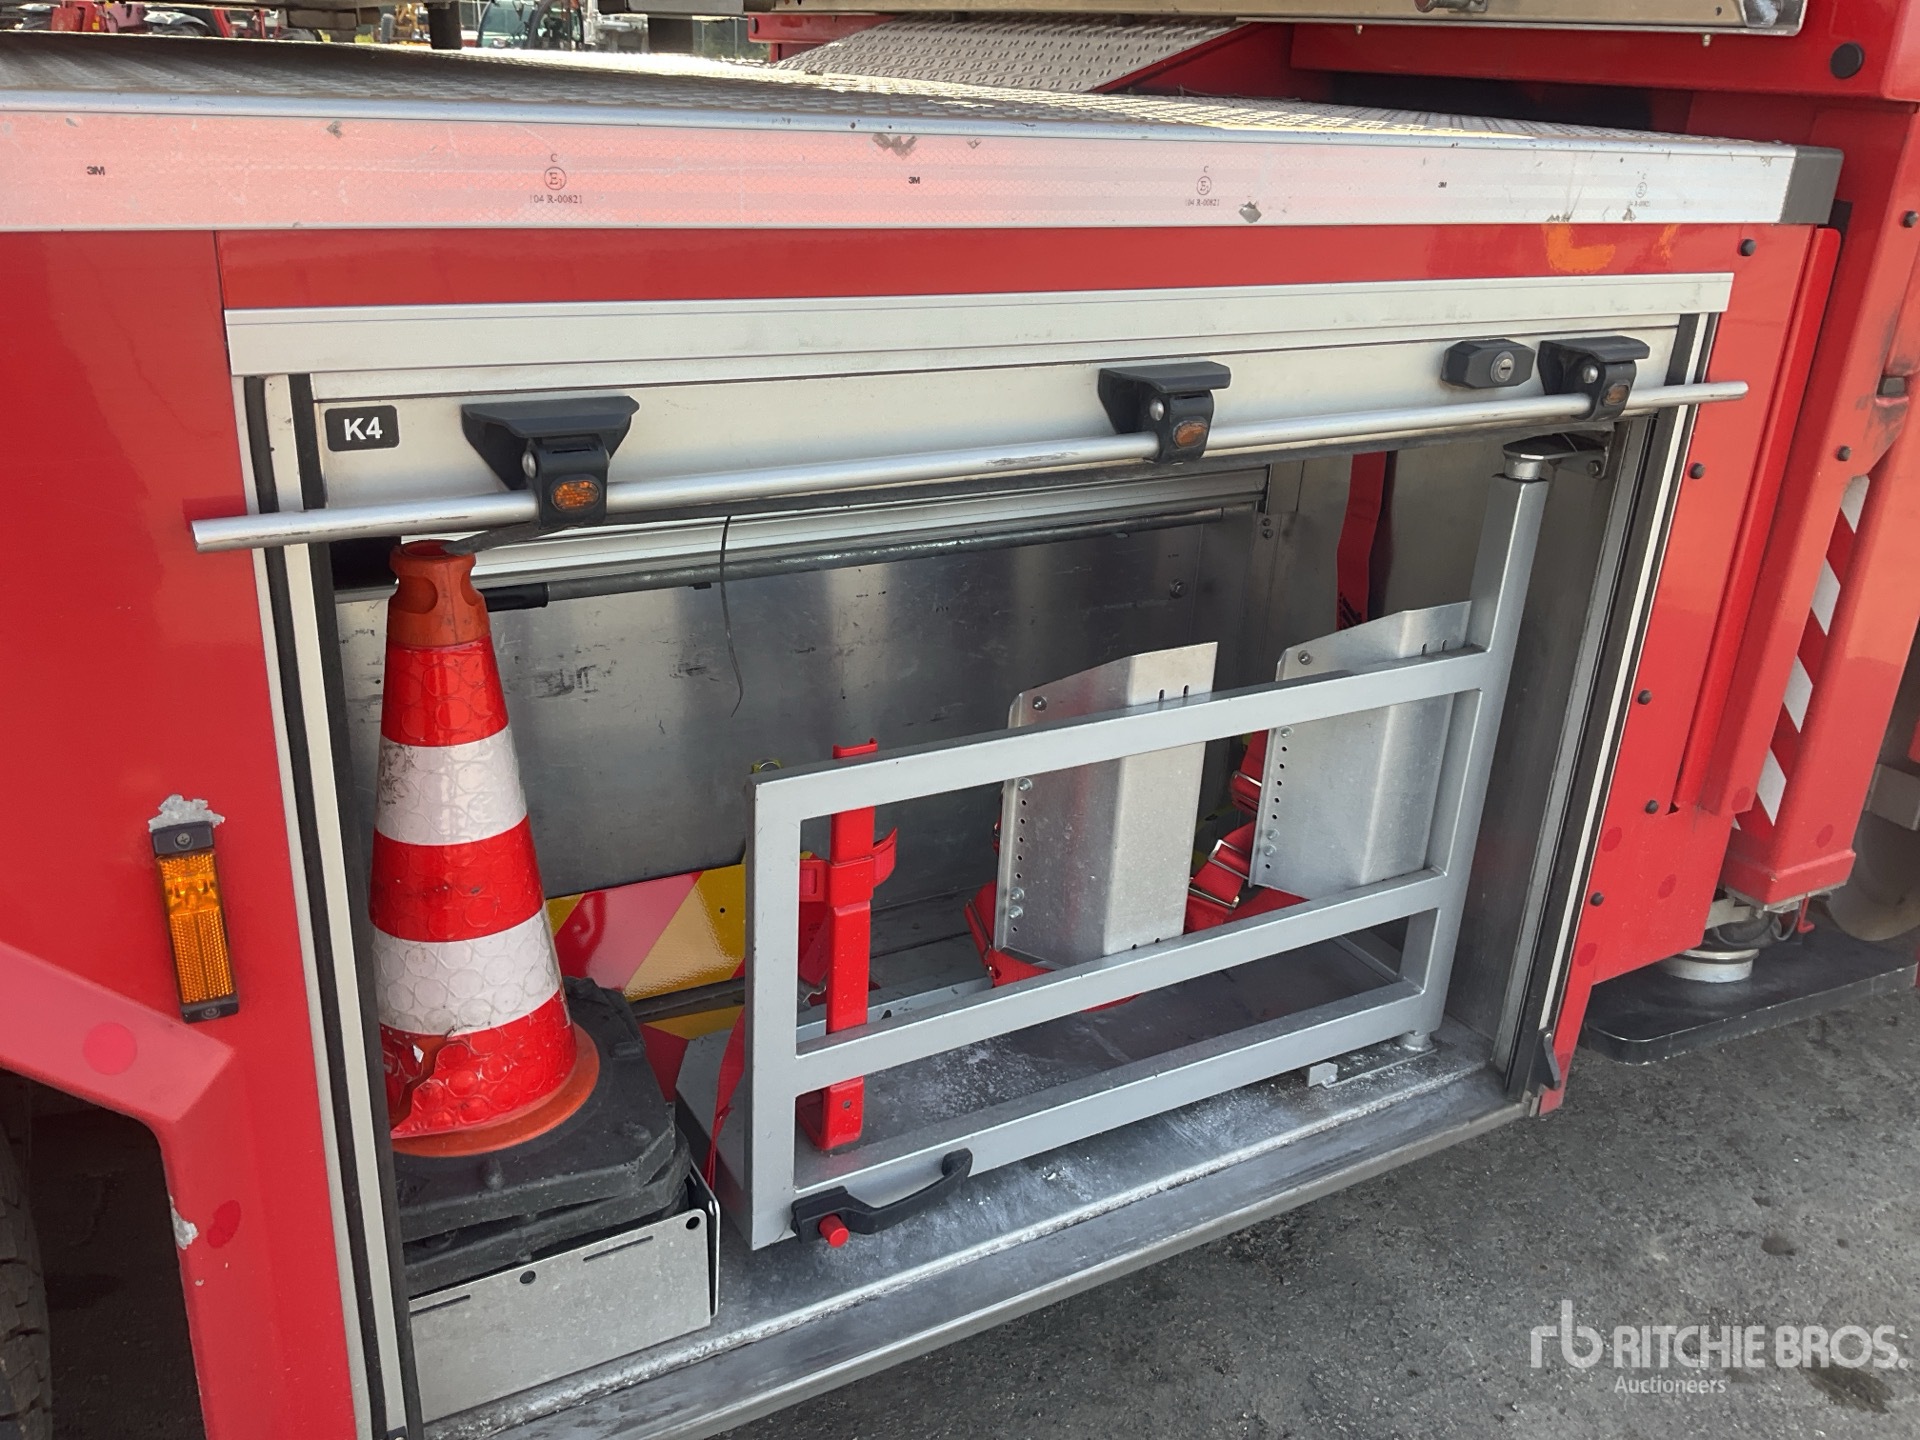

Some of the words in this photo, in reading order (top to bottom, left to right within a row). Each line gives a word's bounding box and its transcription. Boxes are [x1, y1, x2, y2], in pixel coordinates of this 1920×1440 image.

[87, 166, 105, 175] 3M
[908, 176, 921, 184] 3M
[344, 416, 383, 441] K4
